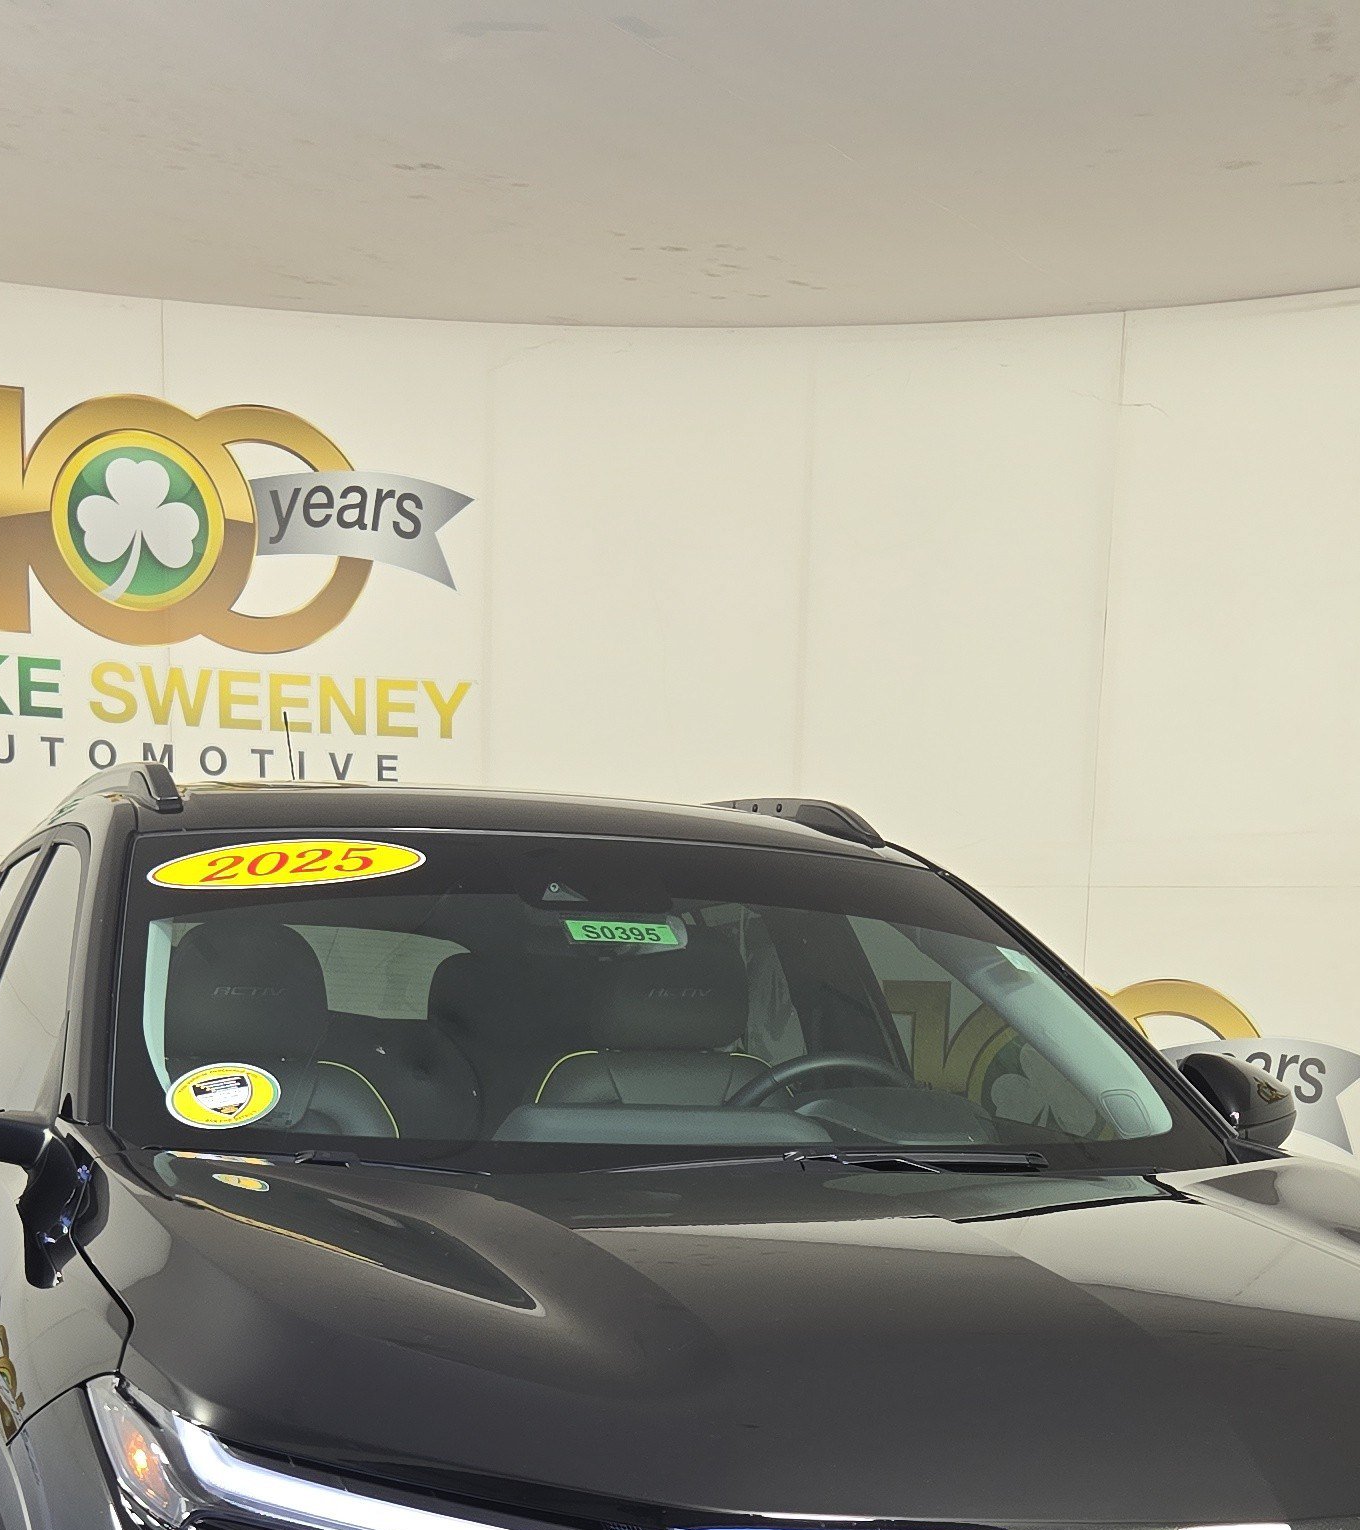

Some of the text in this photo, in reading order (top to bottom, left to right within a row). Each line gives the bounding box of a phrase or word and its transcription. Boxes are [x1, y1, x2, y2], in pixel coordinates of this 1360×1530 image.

[268, 484, 424, 544] years
[89, 661, 473, 740] SWEENEY
[200, 846, 375, 884] 2025
[581, 924, 662, 942] S0395
